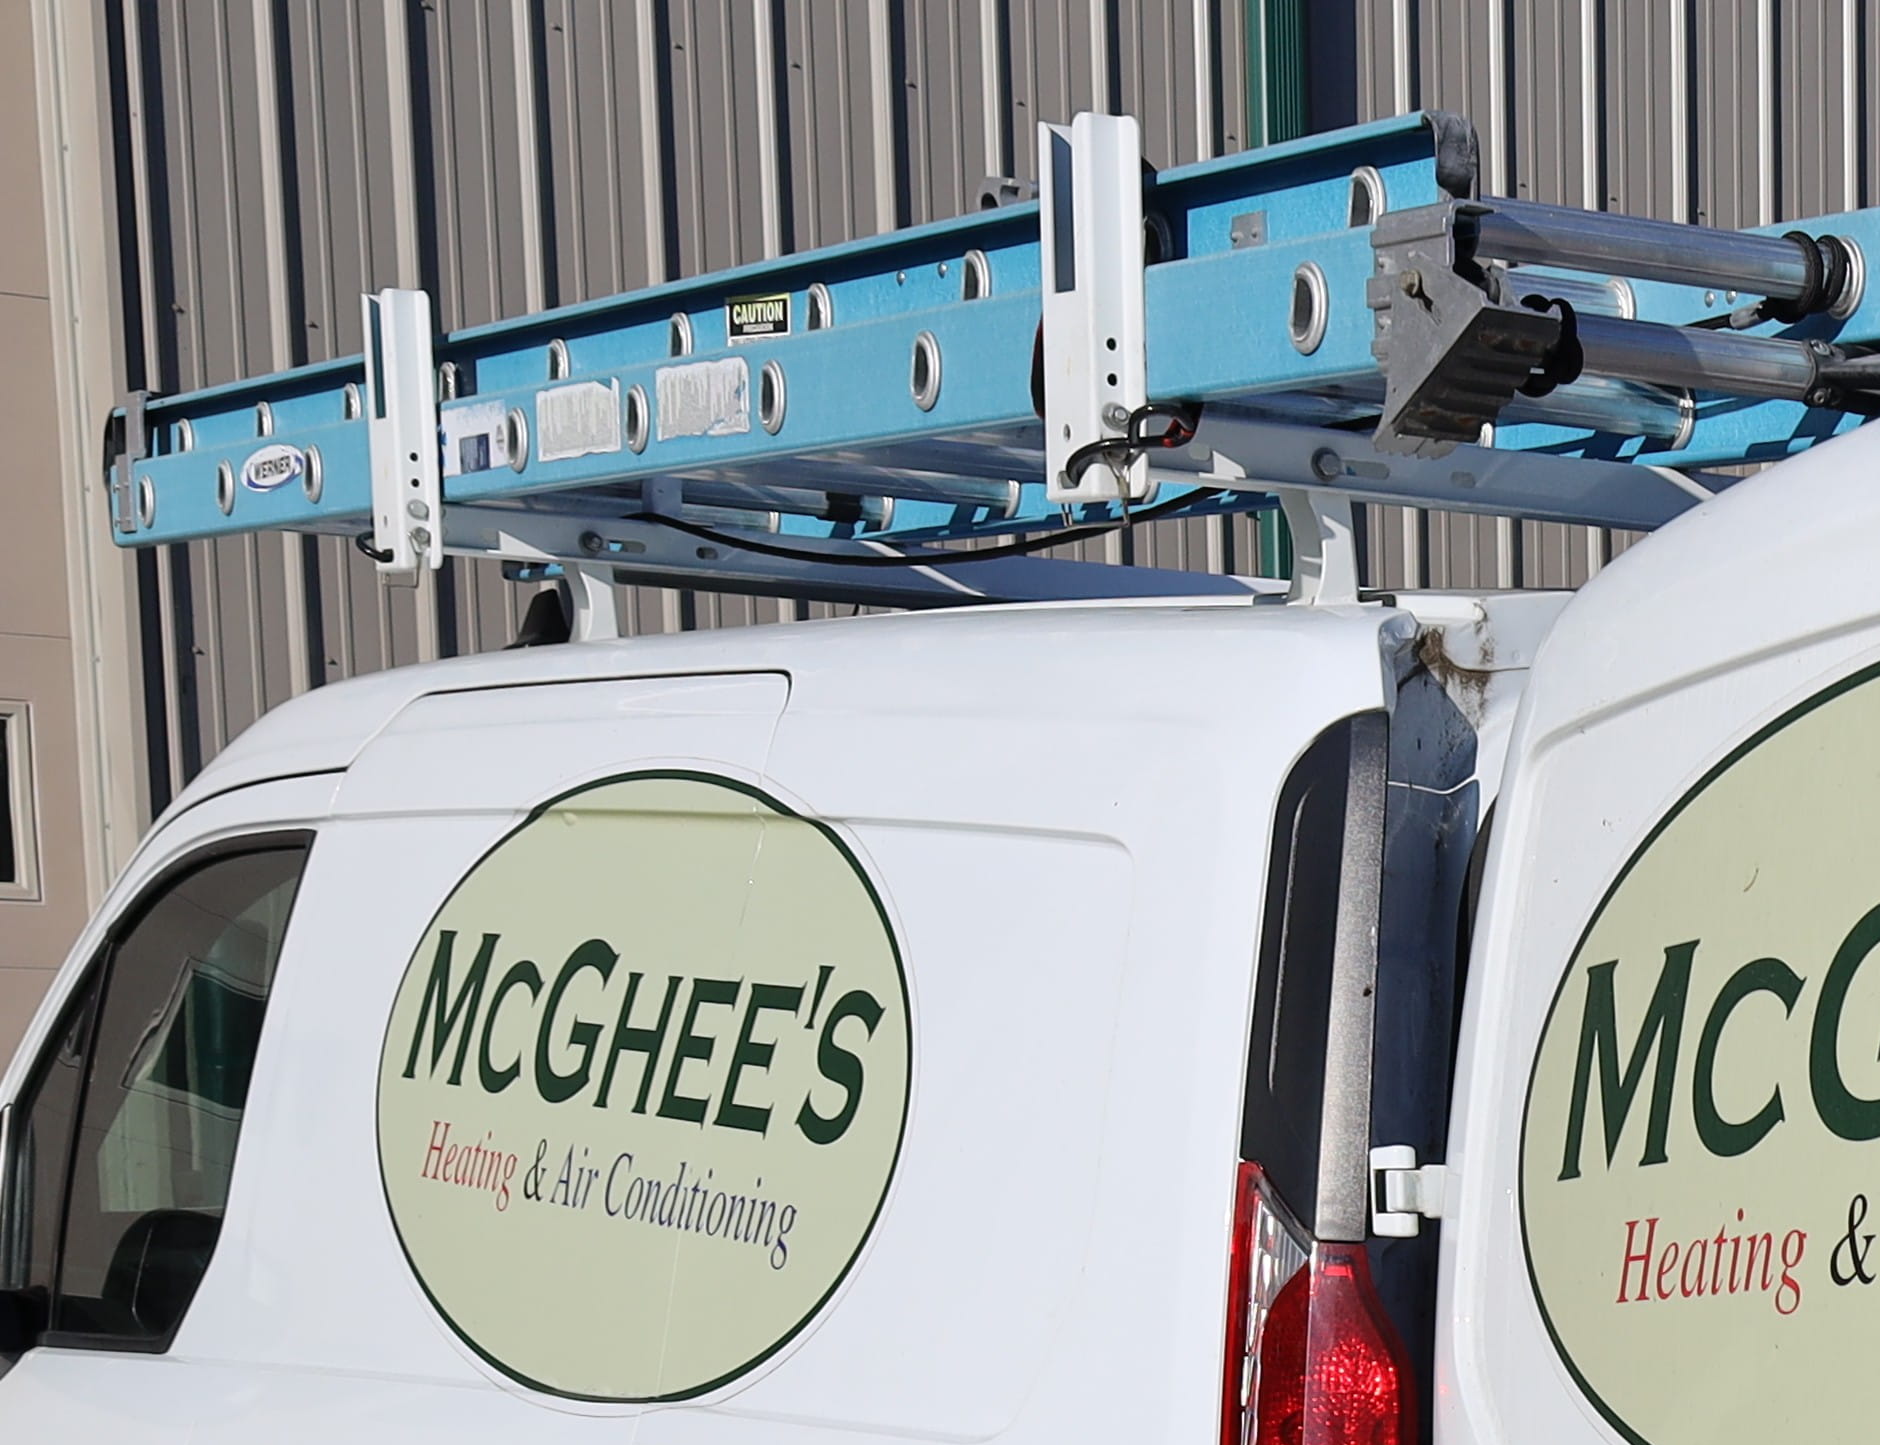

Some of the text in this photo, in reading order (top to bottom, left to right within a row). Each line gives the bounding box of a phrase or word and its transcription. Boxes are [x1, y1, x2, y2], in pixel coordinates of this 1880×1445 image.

[733, 301, 784, 325] CAUTION
[420, 1121, 798, 1270] Heating & Air Conditioning
[1615, 1207, 1807, 1315] Heating
[1830, 1194, 1876, 1286] &
